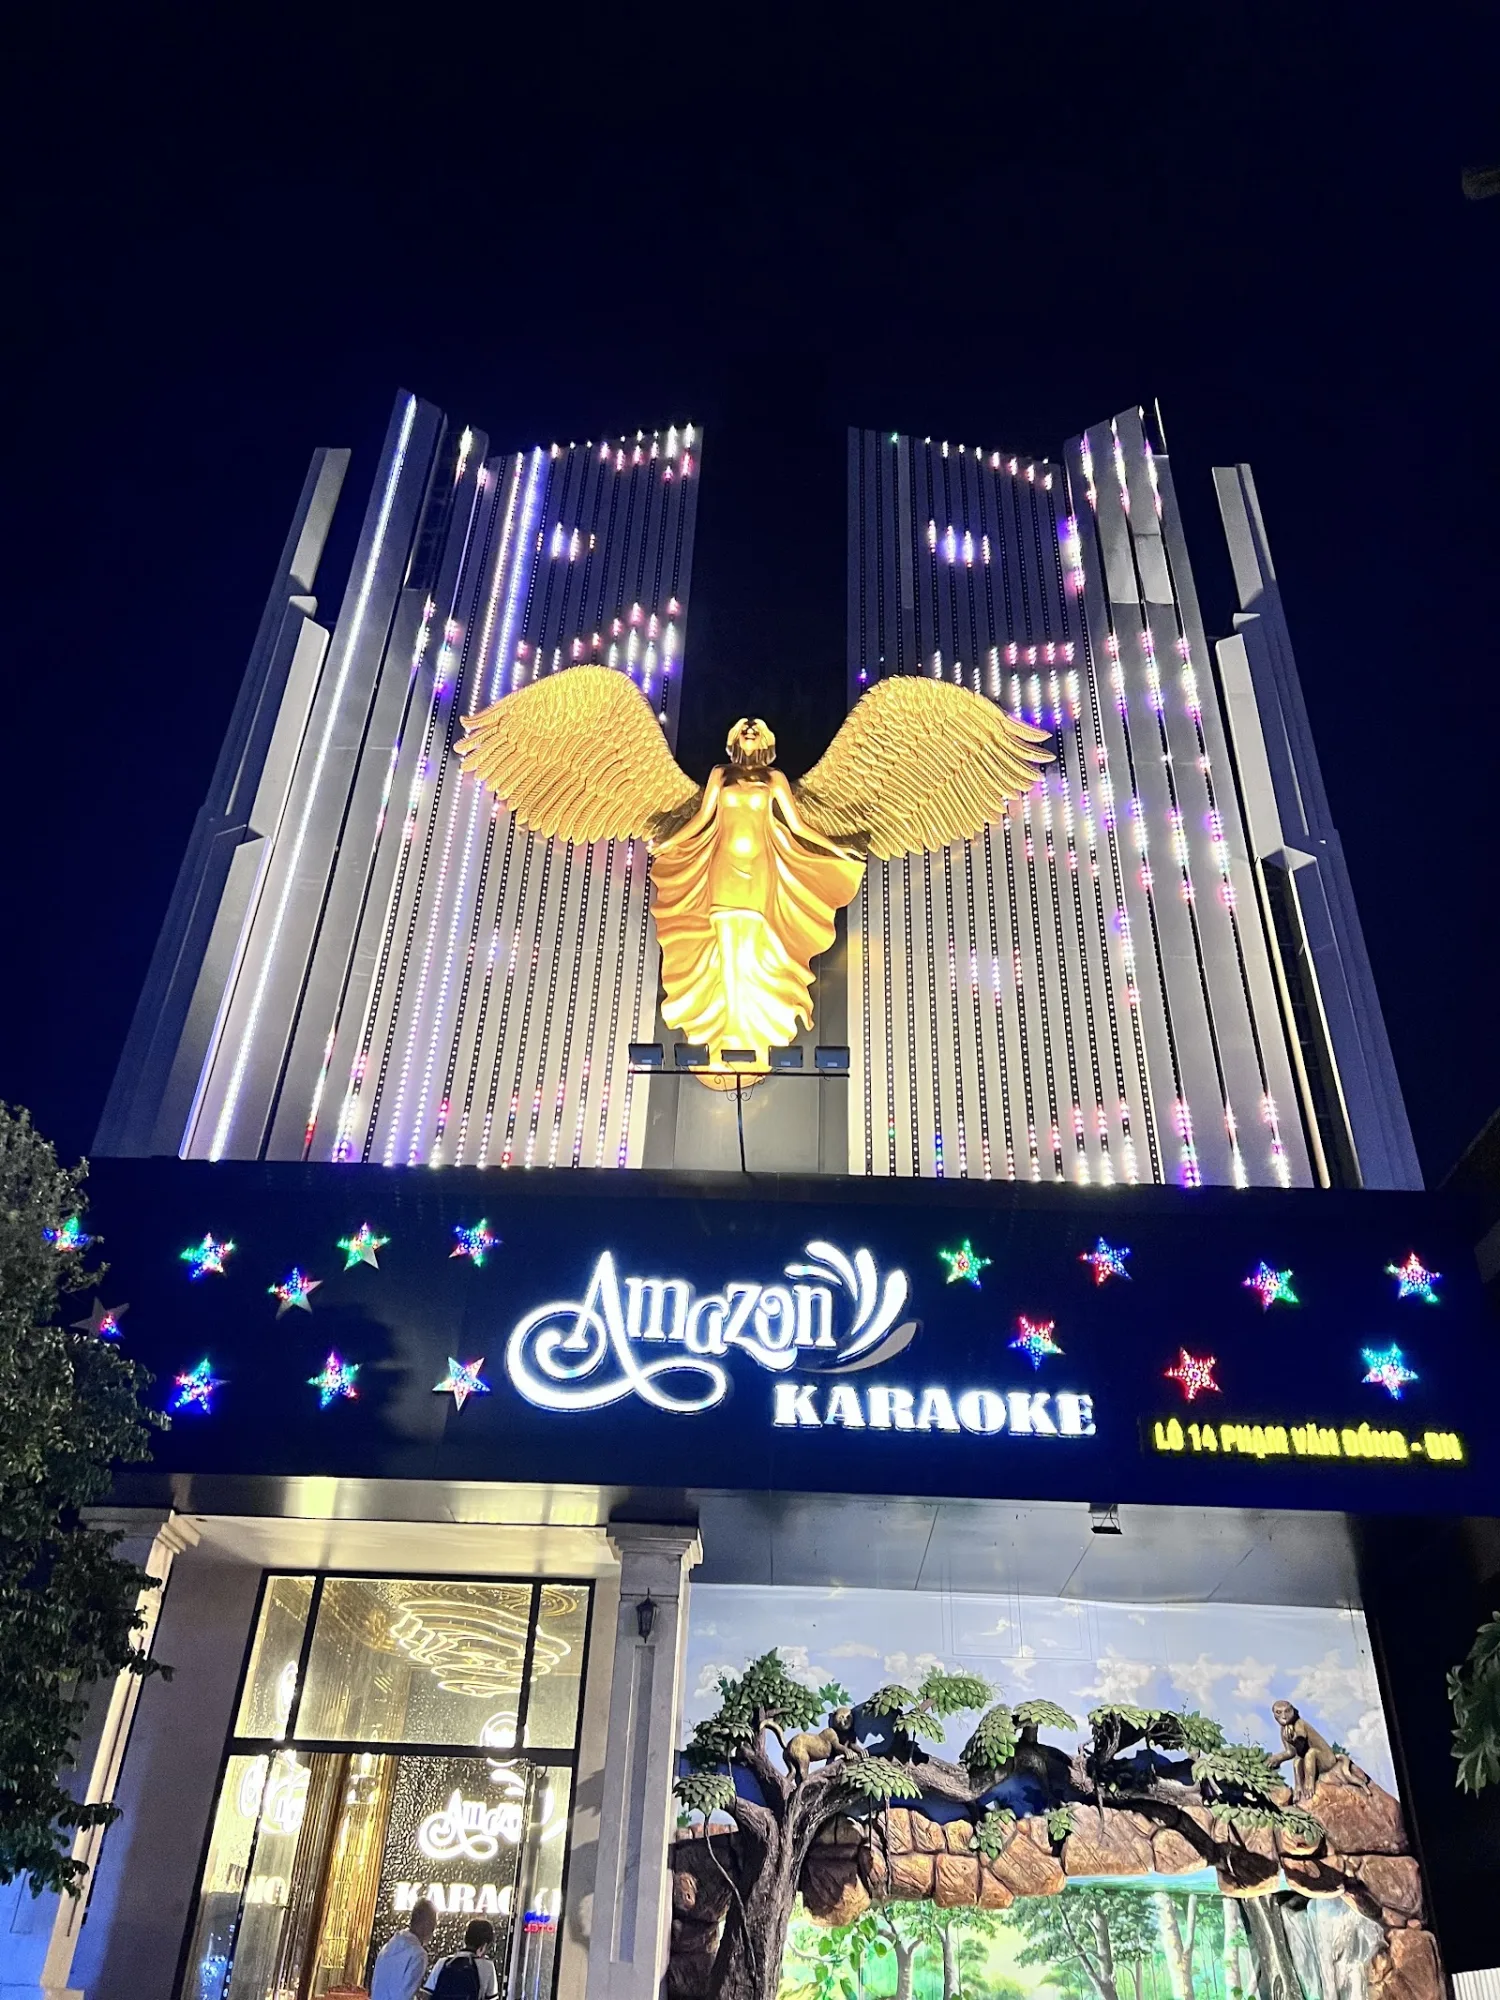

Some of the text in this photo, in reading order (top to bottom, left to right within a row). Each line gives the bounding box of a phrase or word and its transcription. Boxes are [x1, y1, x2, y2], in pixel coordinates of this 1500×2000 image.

[506, 1250, 838, 1414] Amazon
[773, 1383, 1097, 1437] KARAOKE
[1188, 1423, 1218, 1452] 14
[418, 1788, 523, 1860] Amazo
